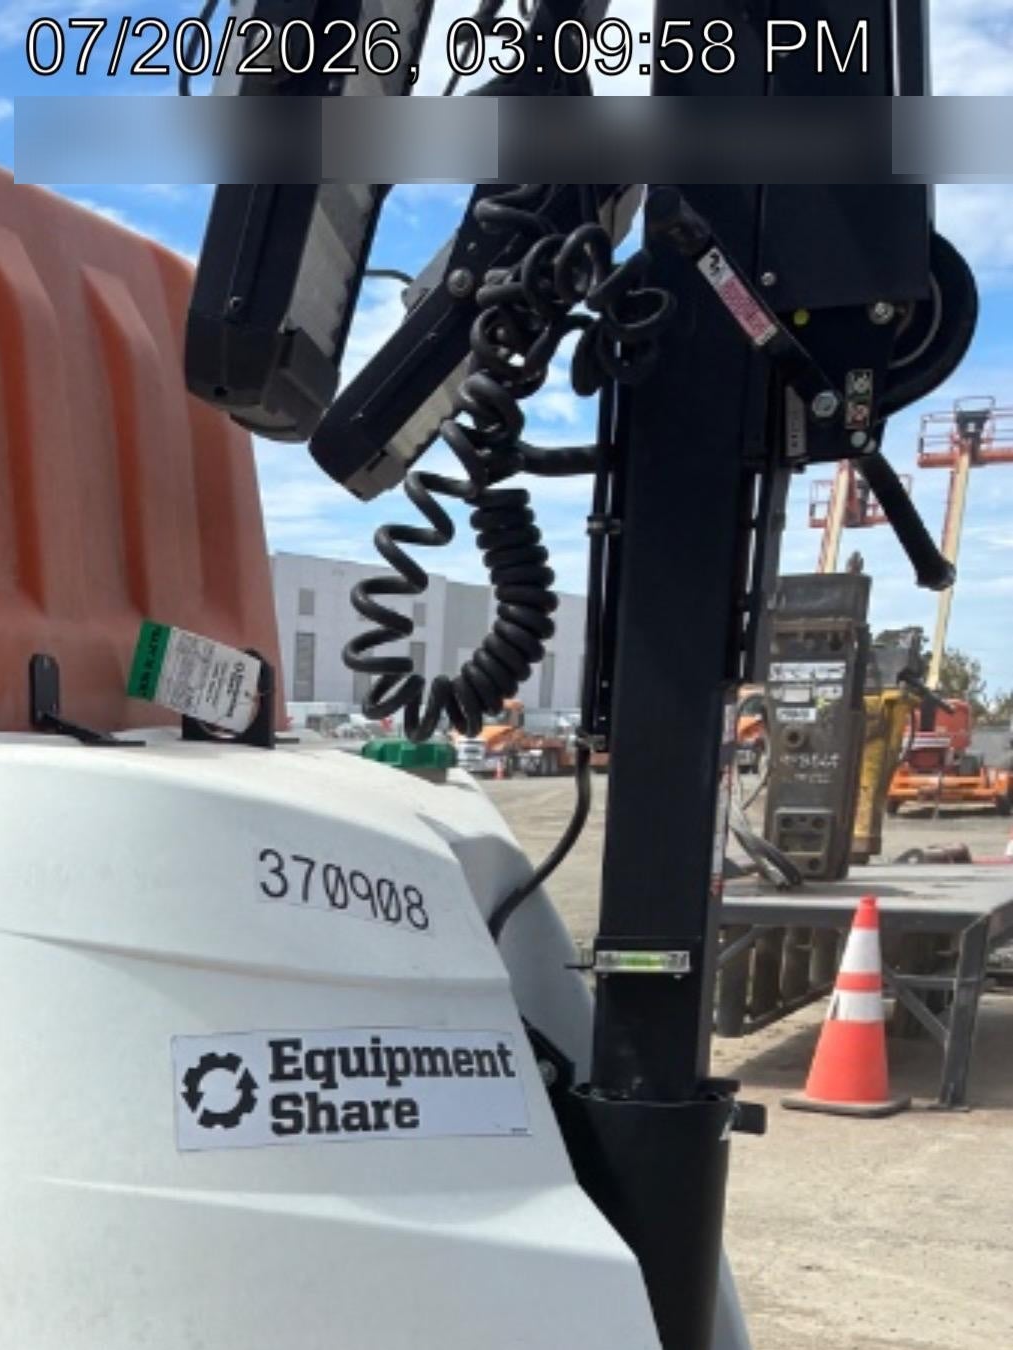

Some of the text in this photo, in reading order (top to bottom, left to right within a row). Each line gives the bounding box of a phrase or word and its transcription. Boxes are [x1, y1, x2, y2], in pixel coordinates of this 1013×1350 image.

[258, 848, 430, 931] 370908
[268, 1035, 516, 1090] Equipment
[270, 1091, 420, 1137] Share
